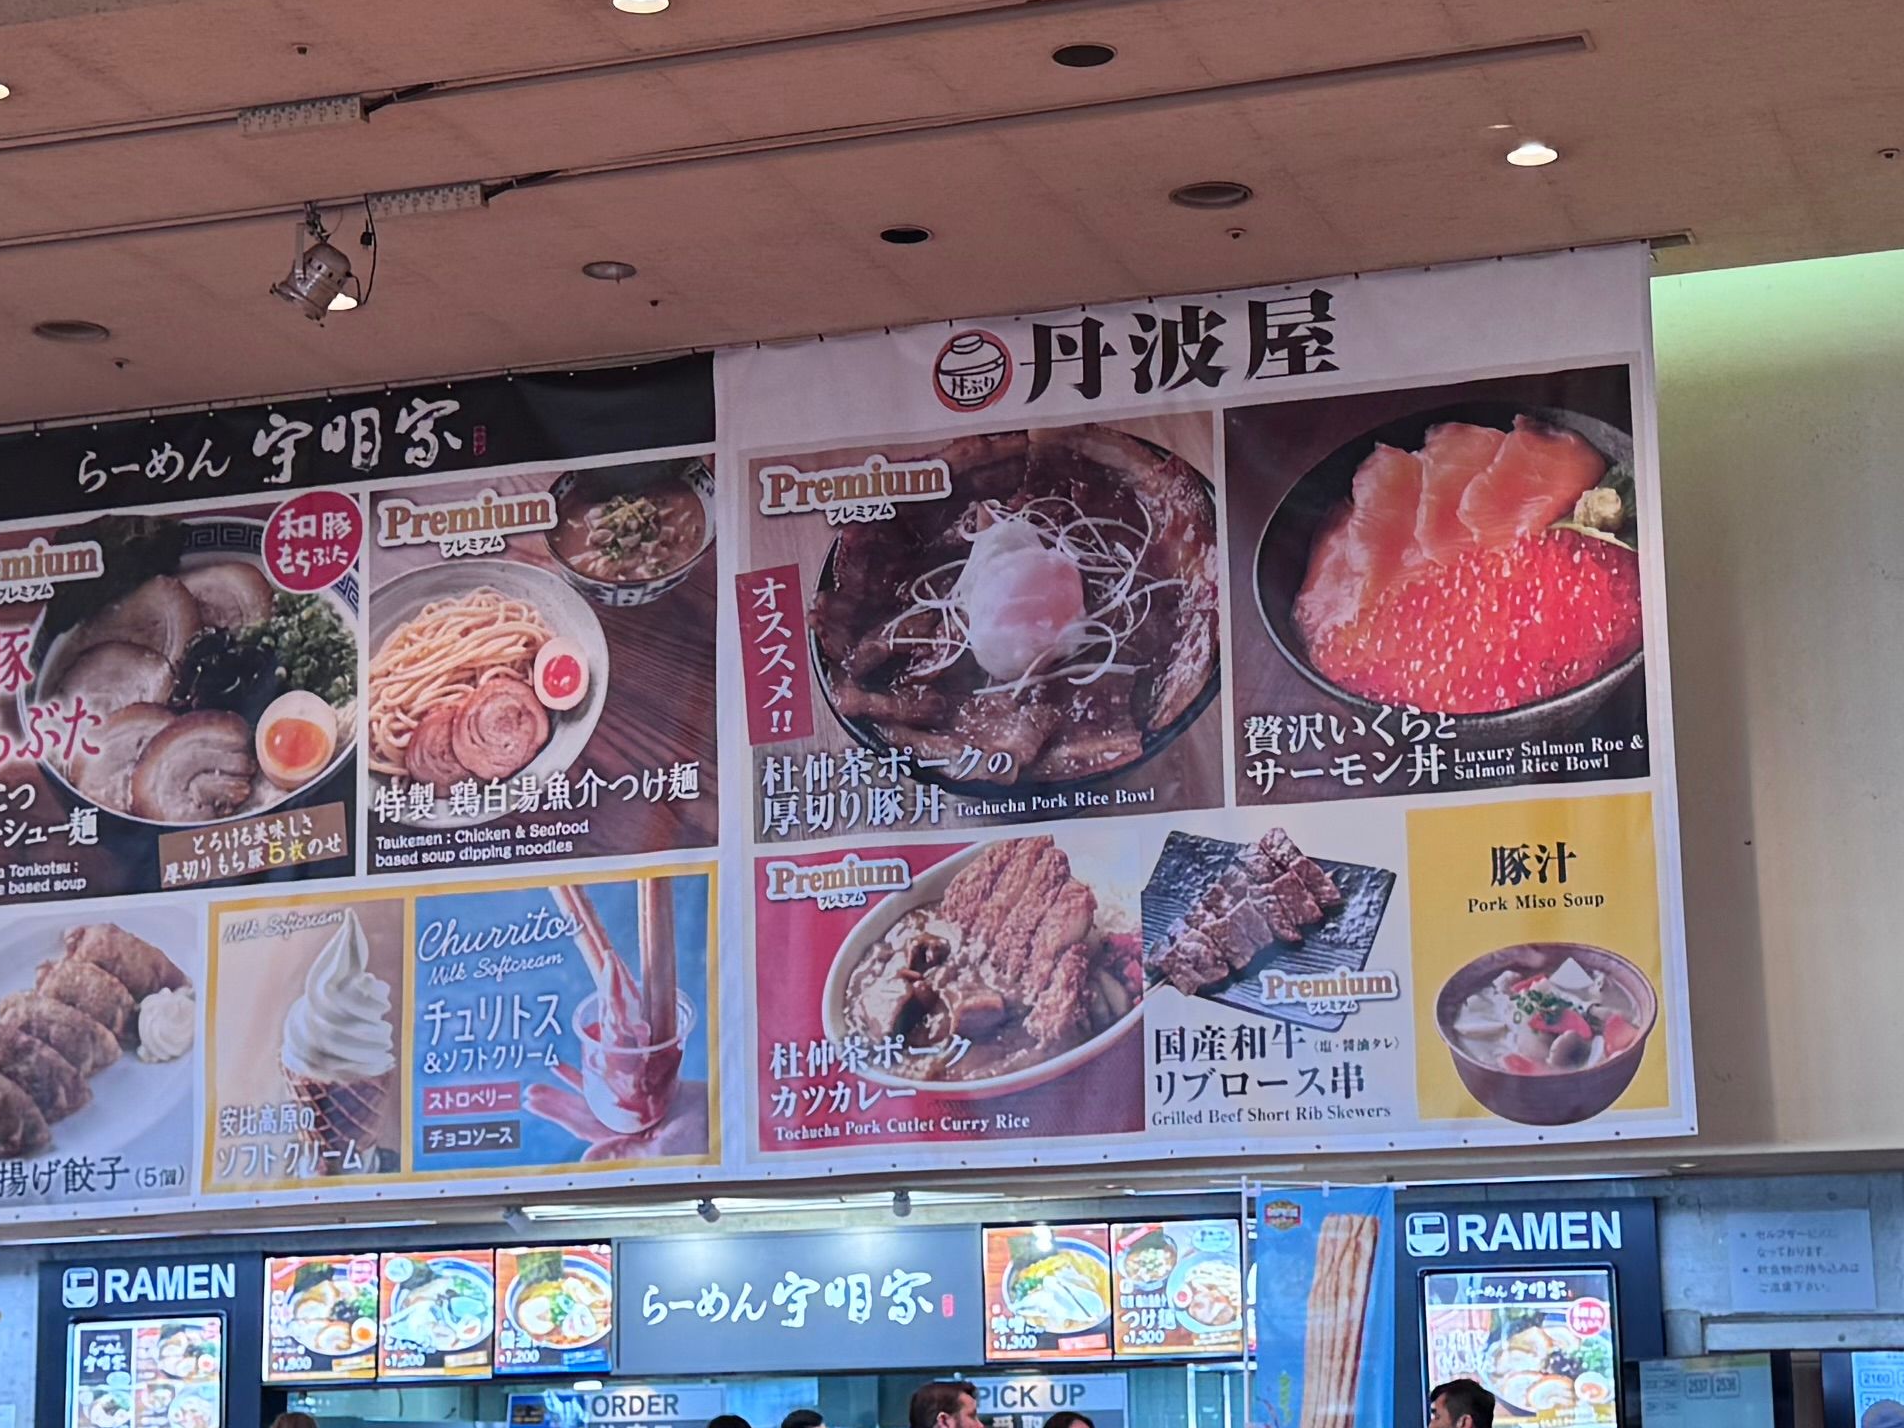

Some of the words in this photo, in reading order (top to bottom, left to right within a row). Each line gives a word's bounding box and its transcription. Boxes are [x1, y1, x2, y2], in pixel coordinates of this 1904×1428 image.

[1020, 287, 1340, 405] 丹波屋
[78, 438, 232, 492] らーめん
[767, 461, 946, 509] Premium
[278, 508, 353, 540] 和豚
[384, 494, 550, 540] Premium
[827, 503, 893, 523] プレミアム
[276, 544, 349, 577] もちぶた
[443, 536, 504, 556] プレミアム
[752, 577, 797, 734] オススメ!!
[1245, 704, 1457, 758] 贅沢いくらと
[1454, 744, 1515, 764] Luxury
[1520, 739, 1586, 757] Salmon
[1591, 736, 1624, 753] Roe
[1629, 733, 1645, 750] &
[762, 744, 1013, 797] 杜仲茶ポークの
[1245, 743, 1447, 796] サーモン丼
[1454, 763, 1515, 781] Salmon
[1521, 757, 1559, 774] Rice
[1566, 752, 1610, 770] Bowl
[374, 776, 437, 824] 特製
[449, 761, 701, 816] 鶏白湯魚介つけ麺
[762, 783, 948, 837] 厚切り豚丼
[955, 798, 1026, 818] Tochucha
[1032, 794, 1068, 813] Pork
[1074, 790, 1109, 808] Rice
[1114, 786, 1155, 805] Bowl
[192, 813, 313, 854] とろける美味しさ
[376, 833, 443, 850] Tsukemen
[455, 826, 510, 844] Chicken
[515, 826, 526, 840] &
[530, 820, 589, 838] Seafood
[10, 863, 71, 880] Tonkotsu
[376, 851, 418, 868] based
[422, 848, 455, 864] soup
[459, 843, 512, 862] dipping
[516, 840, 573, 856] noodles
[1490, 841, 1577, 887] 豚汁
[9, 878, 50, 895] based
[53, 876, 86, 894] soup
[772, 858, 905, 896] Premium
[1468, 897, 1508, 913] Pork
[1515, 894, 1556, 910] Miso
[1563, 892, 1604, 908] Soup
[418, 906, 585, 961] Churritos
[428, 965, 467, 986] Milk
[1265, 970, 1394, 1000] Premium
[424, 993, 561, 1046] チュリトス
[423, 1043, 559, 1075] &ソフトクリーム
[769, 1034, 972, 1081] 杜仲茶ポーク
[1154, 1021, 1306, 1065] 国産和牛
[428, 1088, 513, 1110] ストロベリー
[770, 1080, 917, 1118] カツカレー
[1155, 1062, 1365, 1106] リブロース串
[220, 1104, 316, 1138] 安比高原の
[773, 1123, 840, 1142] Tochucha
[845, 1119, 881, 1136] Pork
[886, 1118, 935, 1133] Cutlet
[939, 1116, 990, 1133] Curry
[995, 1113, 1031, 1129] Rice
[1152, 1110, 1203, 1126] Grilled
[1209, 1108, 1243, 1123] Beef
[1248, 1106, 1290, 1122] Short
[1296, 1106, 1322, 1120] Rib
[1328, 1104, 1391, 1119] Skewers
[428, 1127, 513, 1148] チョコソース
[217, 1138, 362, 1178] ソフトクリーム
[1458, 1211, 1621, 1253] RAMEN
[105, 1263, 235, 1303] RAMEN
[643, 1282, 767, 1326] らーめん
[592, 1394, 678, 1417] ORDER
[978, 1385, 1038, 1408] PICK
[1050, 1383, 1085, 1406] UP
